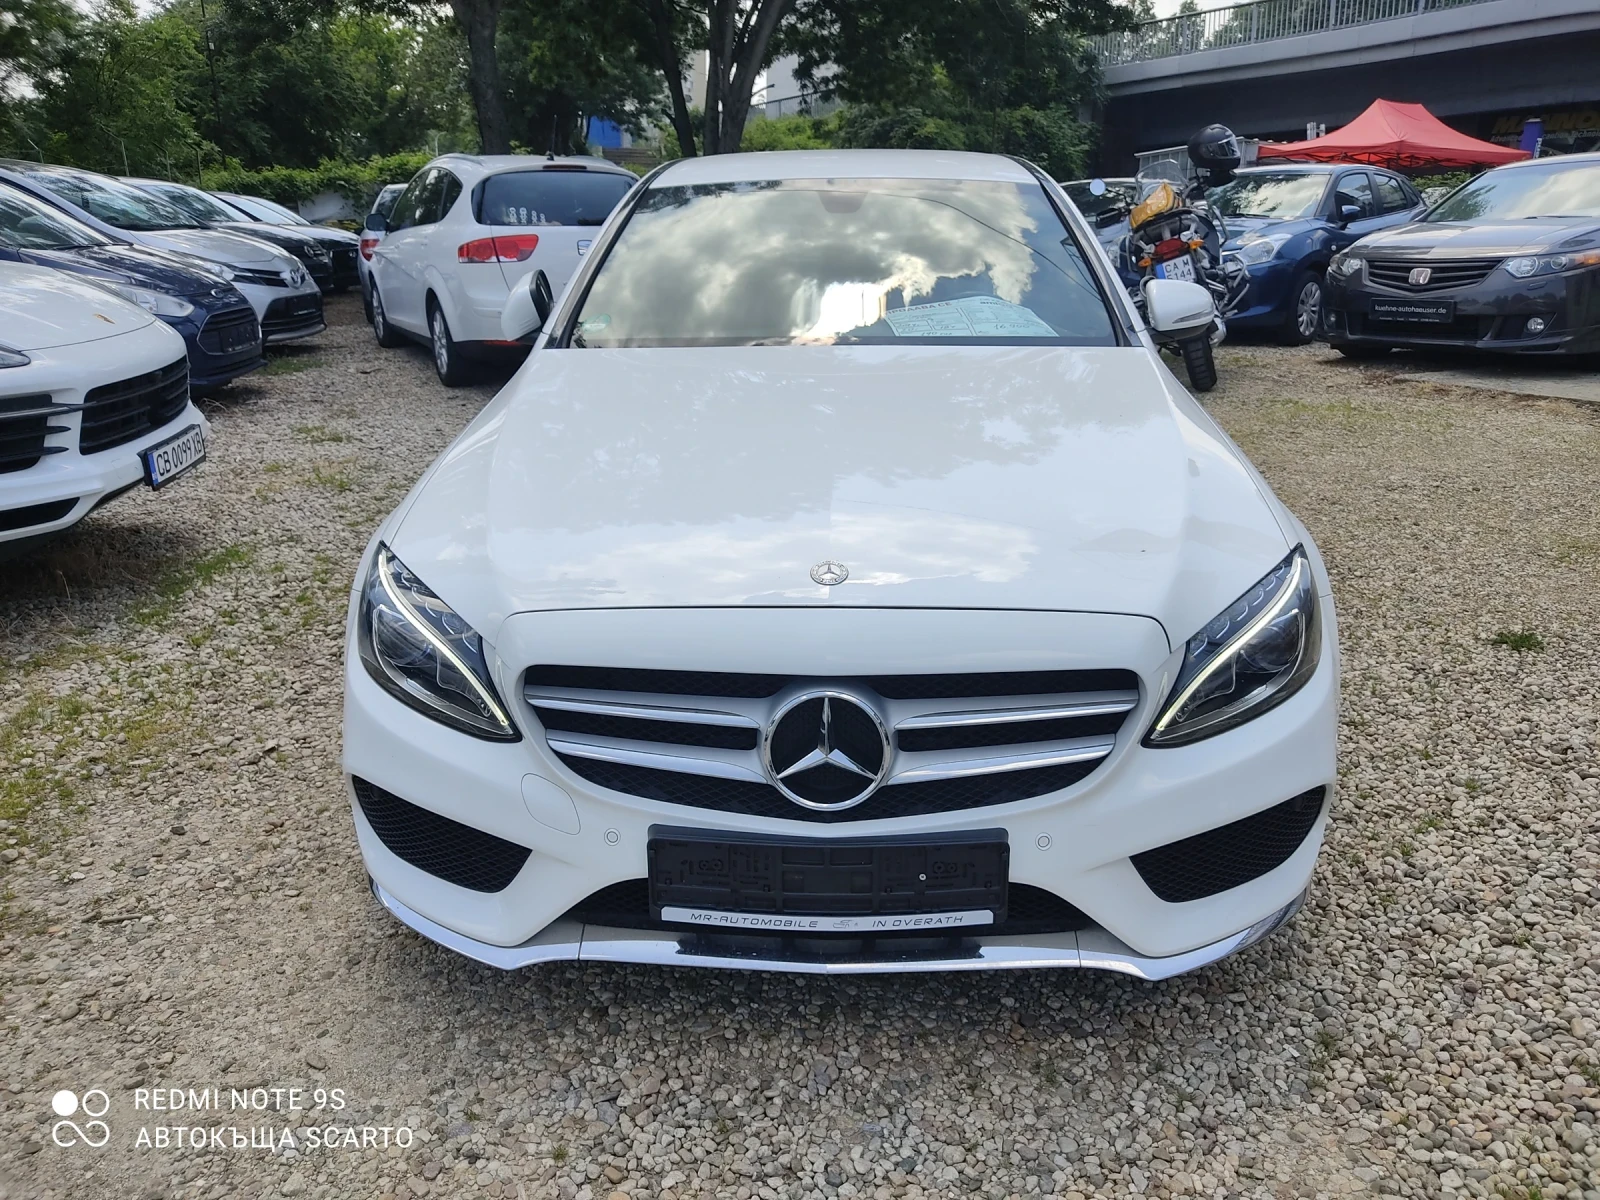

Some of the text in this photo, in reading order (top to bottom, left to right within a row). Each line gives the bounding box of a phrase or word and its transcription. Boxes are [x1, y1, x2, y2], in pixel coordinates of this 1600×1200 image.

[1165, 258, 1190, 273] CA M
[1374, 304, 1447, 315] kuehne-autohaeuser.de
[156, 432, 203, 477] CB 0099 XB
[690, 913, 964, 929] MR-AUTOMOBILE IN OVERATH
